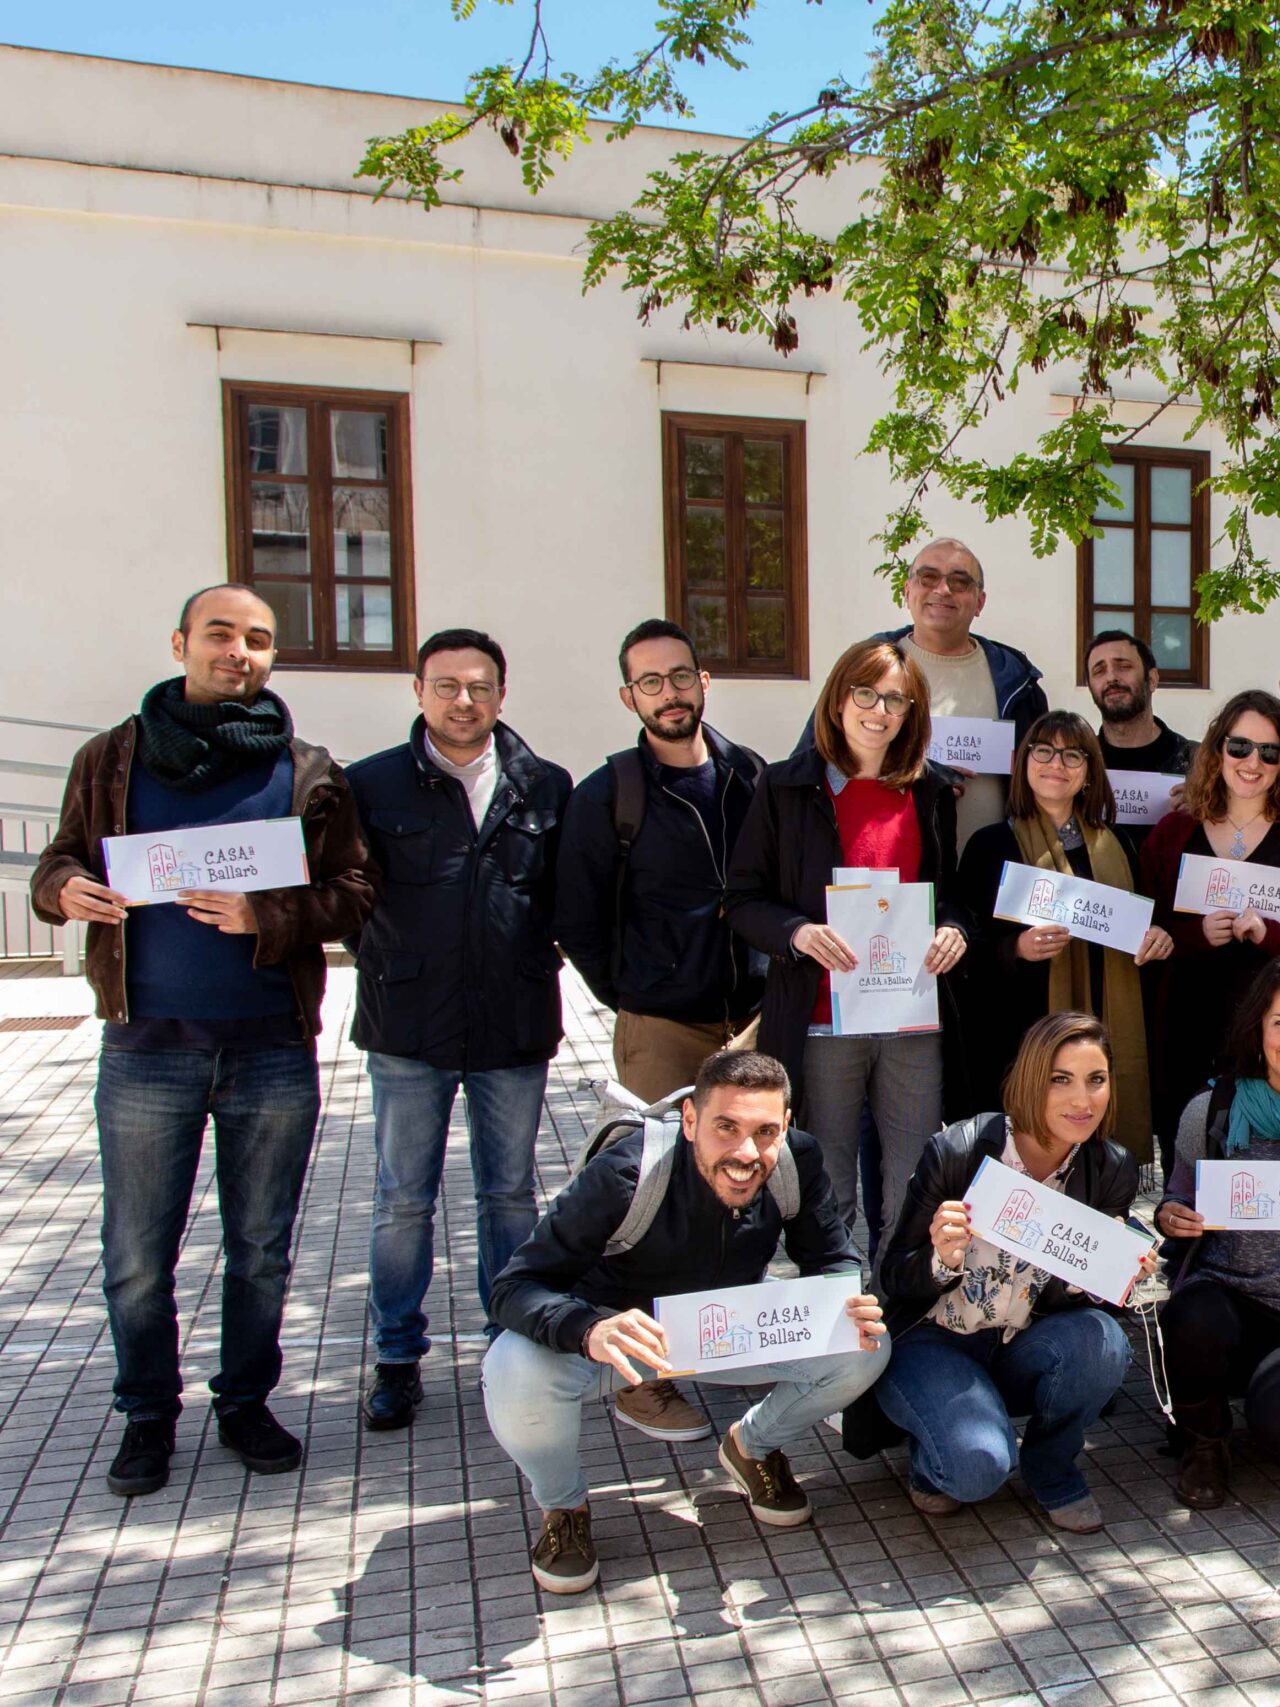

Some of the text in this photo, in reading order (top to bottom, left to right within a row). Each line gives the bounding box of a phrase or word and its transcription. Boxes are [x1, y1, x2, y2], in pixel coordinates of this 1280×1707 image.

[947, 749, 981, 761] Ballarò
[207, 865, 258, 882] Ballarò
[1071, 912, 1110, 932] Ballarò
[1042, 1239, 1089, 1271] Ballarò
[759, 1328, 812, 1348] Ballarò
